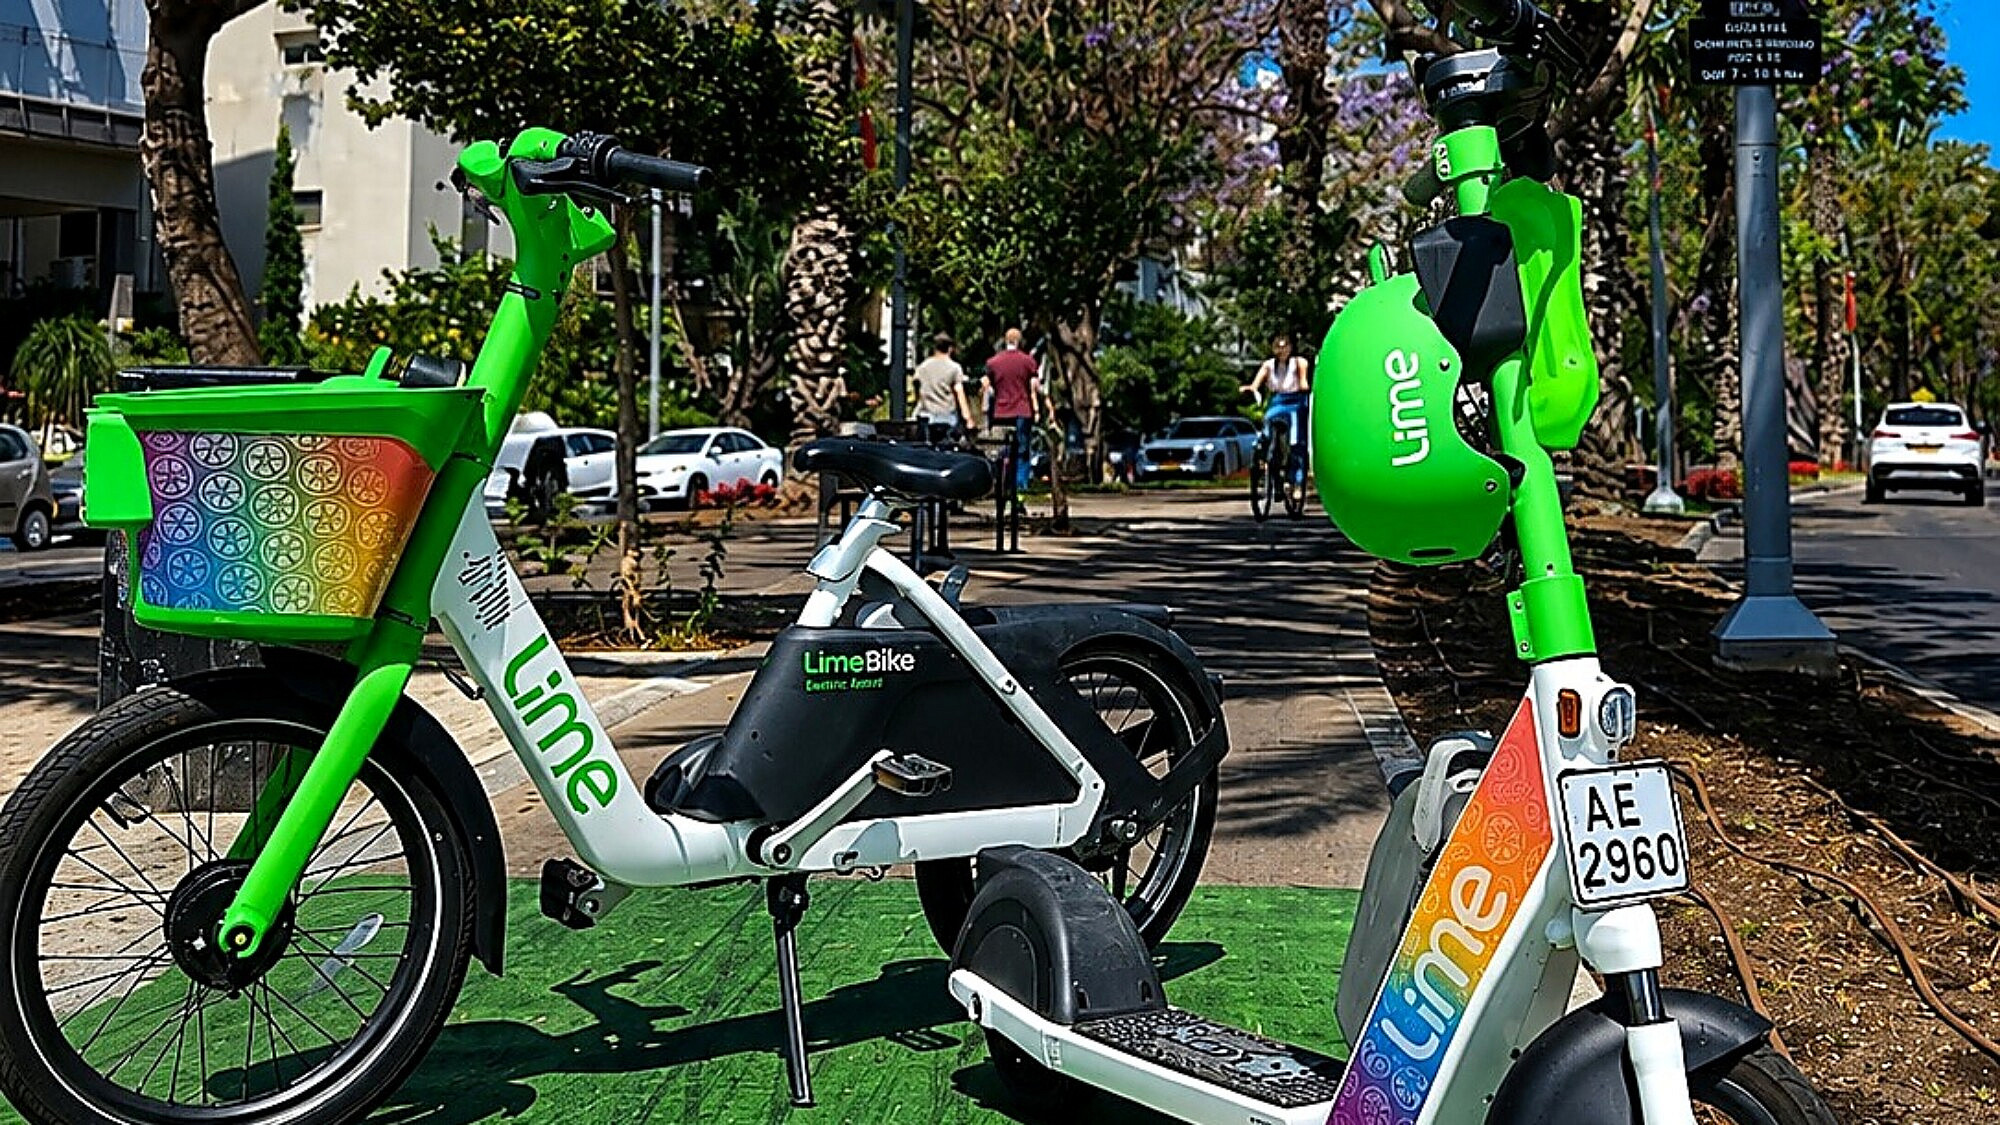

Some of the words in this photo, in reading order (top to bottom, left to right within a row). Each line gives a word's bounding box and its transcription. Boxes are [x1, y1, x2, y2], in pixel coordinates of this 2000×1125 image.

[1384, 348, 1430, 467] Lime
[804, 648, 916, 673] LimeBike
[504, 633, 618, 815] Lime
[1587, 783, 1641, 832] AE
[1579, 833, 1679, 889] 2960
[1380, 865, 1508, 1060] Lime
